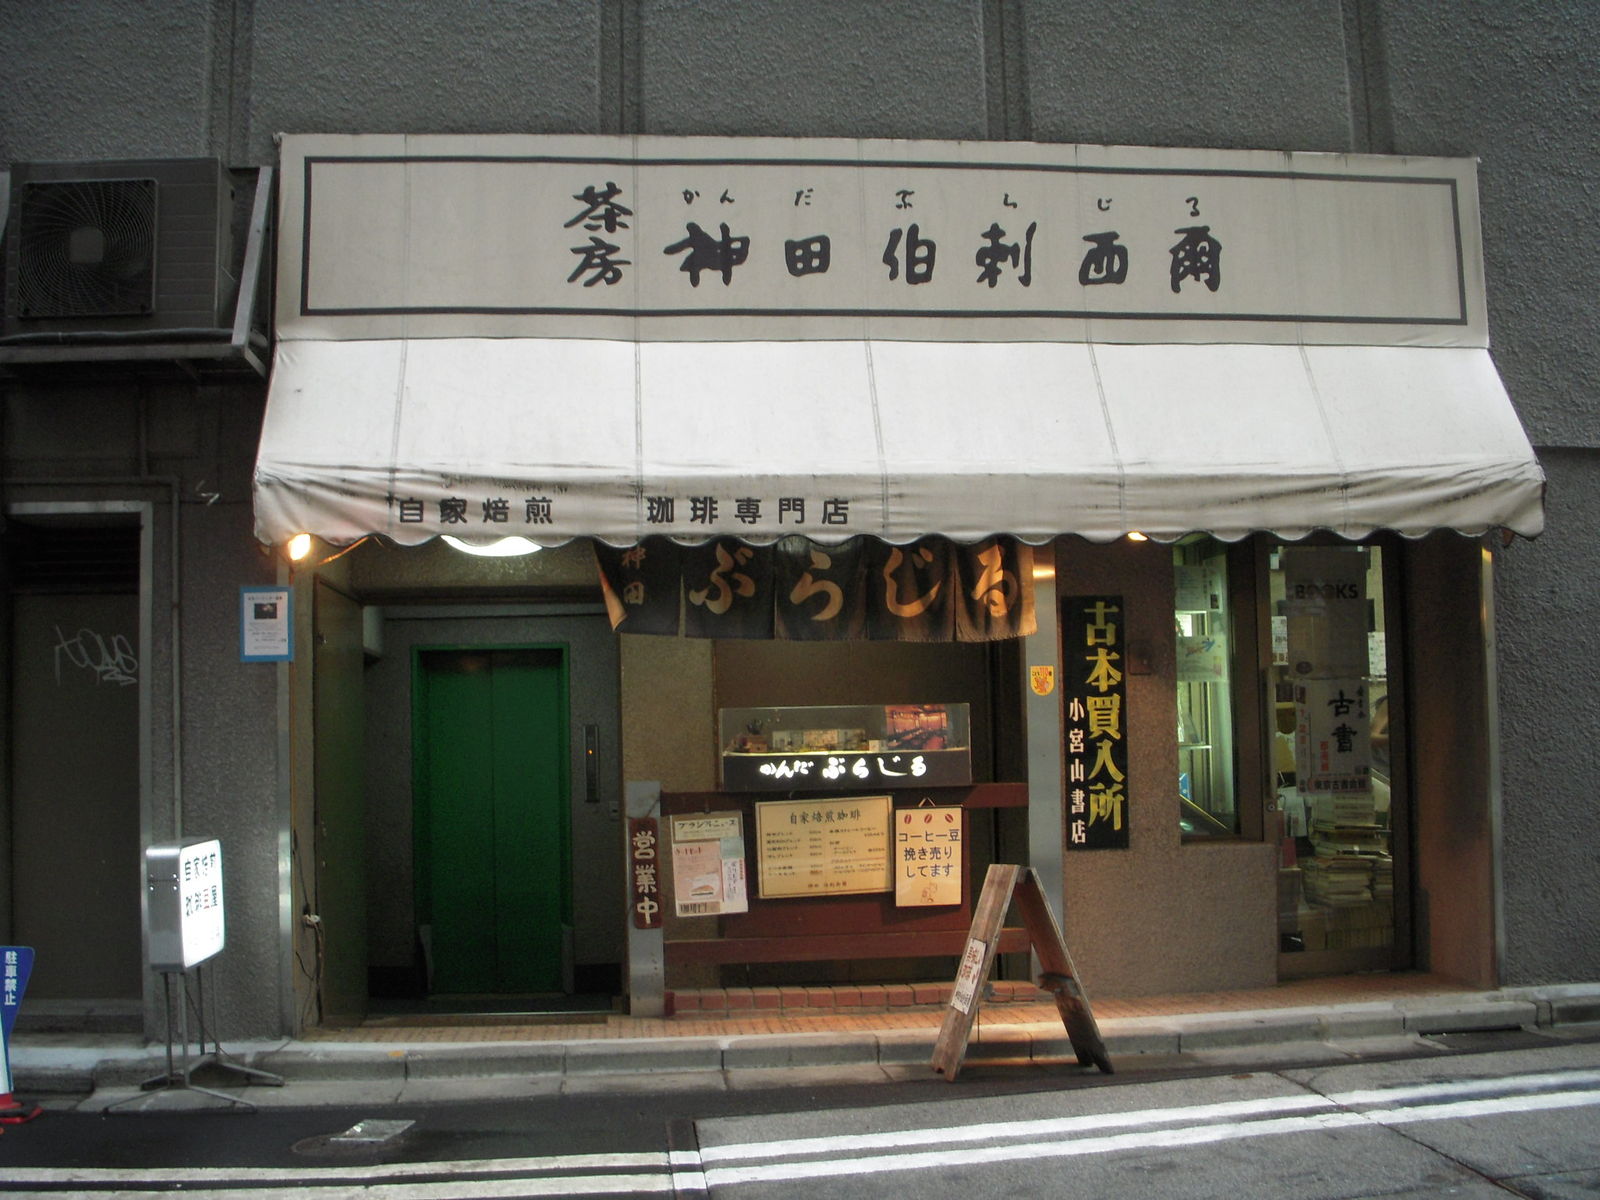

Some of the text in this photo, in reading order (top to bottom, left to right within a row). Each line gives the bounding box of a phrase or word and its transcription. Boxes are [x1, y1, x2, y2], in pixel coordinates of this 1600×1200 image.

[564, 181, 634, 288] 茶房
[400, 496, 850, 525] 自家焙煎 珈琲専門店
[689, 542, 1019, 621] ぶらじる
[1083, 601, 1126, 831] 古本買入所
[1327, 689, 1358, 754] 古書
[1069, 698, 1087, 844] 小宮山書店
[898, 829, 961, 842] コーヒー豆
[903, 847, 953, 862] 挽き売り
[906, 863, 955, 879] してます
[633, 830, 659, 925] 営業中
